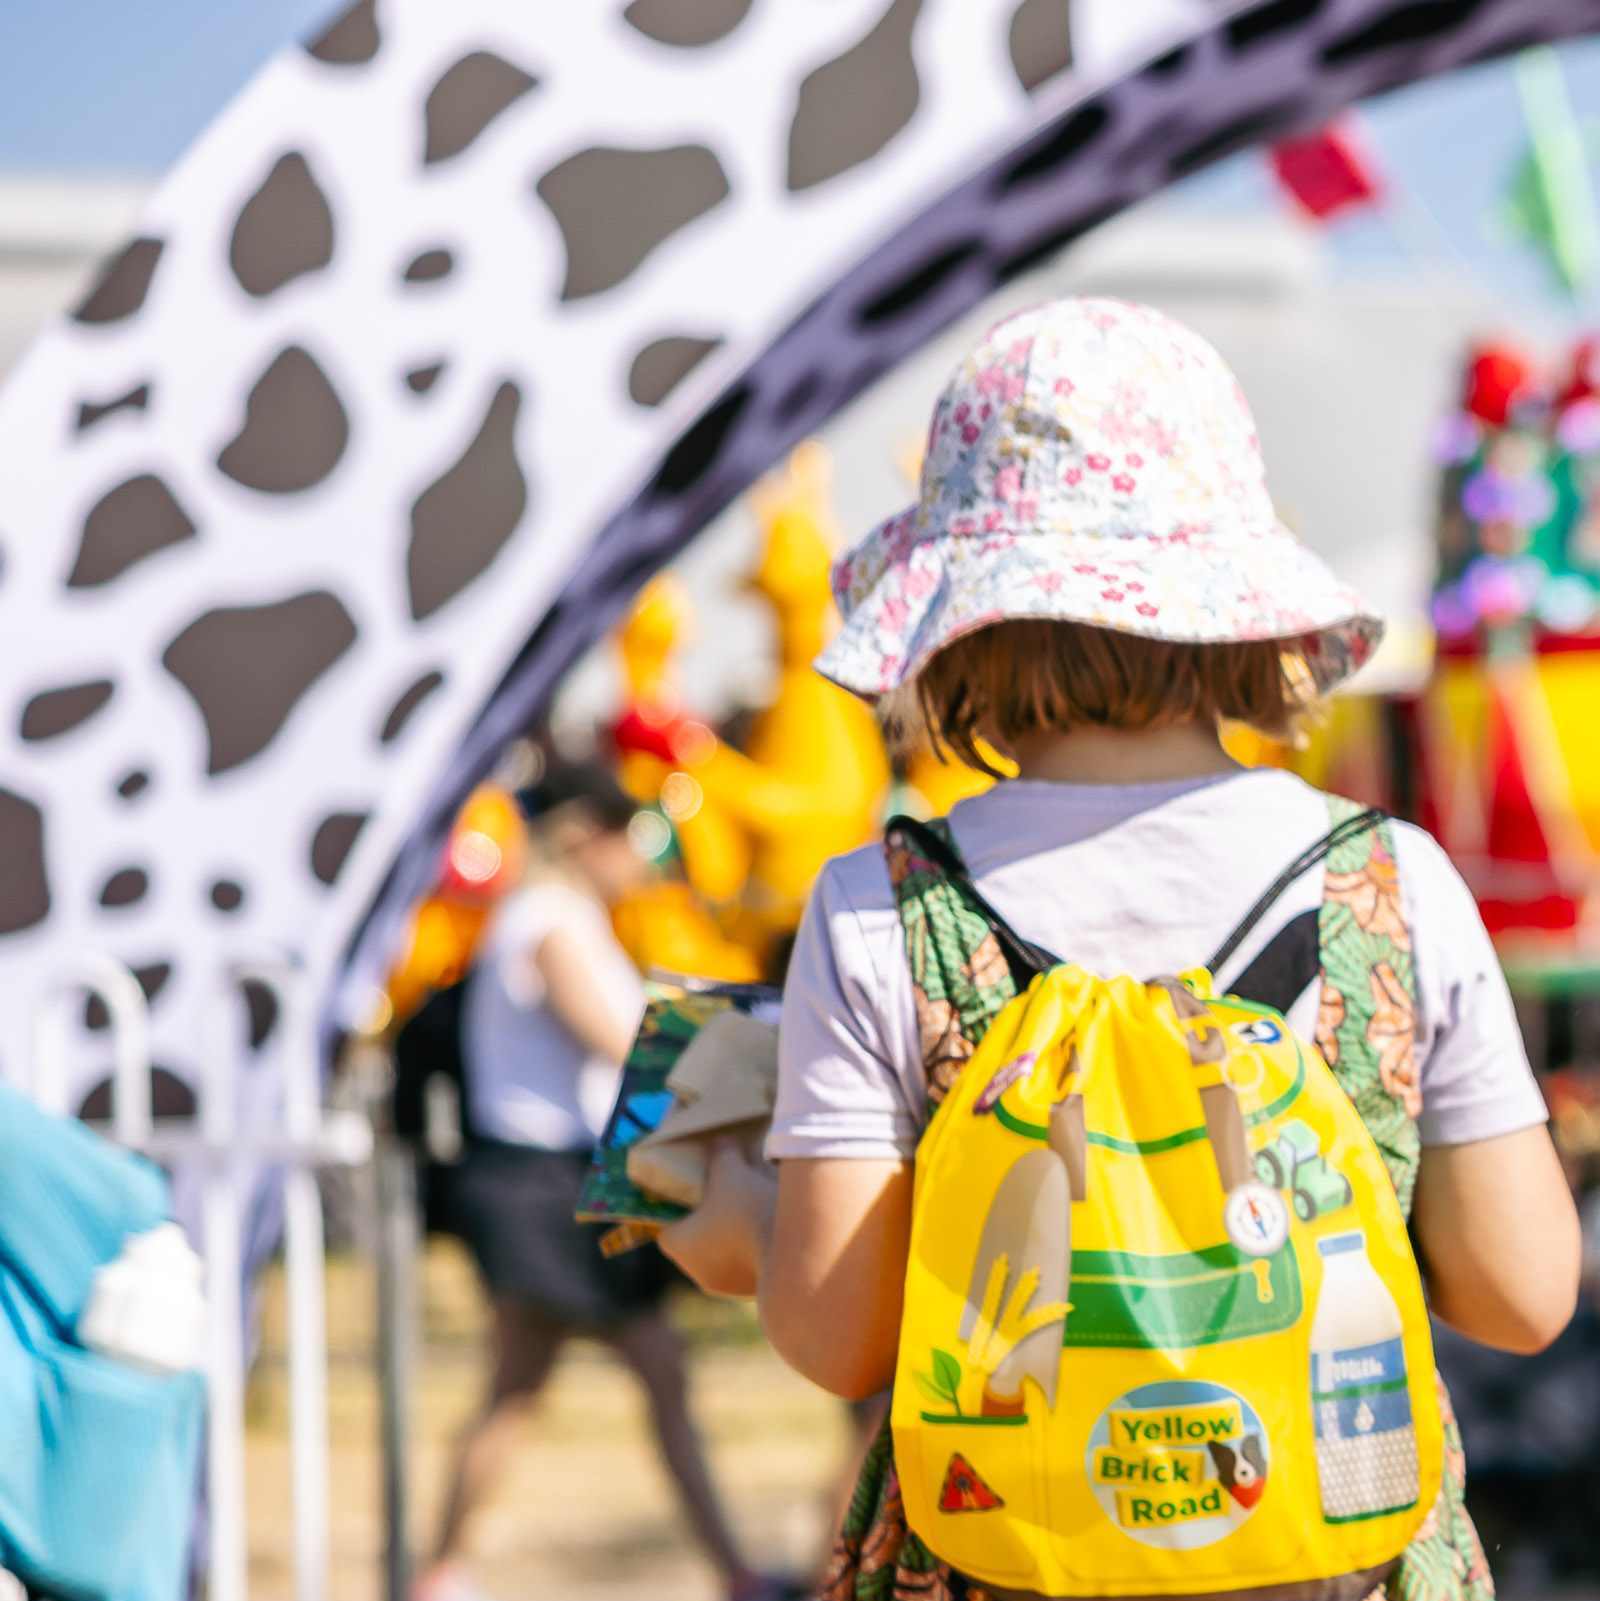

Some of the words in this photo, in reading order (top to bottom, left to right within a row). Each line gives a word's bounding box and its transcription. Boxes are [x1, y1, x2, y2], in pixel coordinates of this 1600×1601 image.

[1121, 1416, 1234, 1443] Yellow
[1101, 1456, 1189, 1483] Brick
[1130, 1488, 1221, 1523] Road
